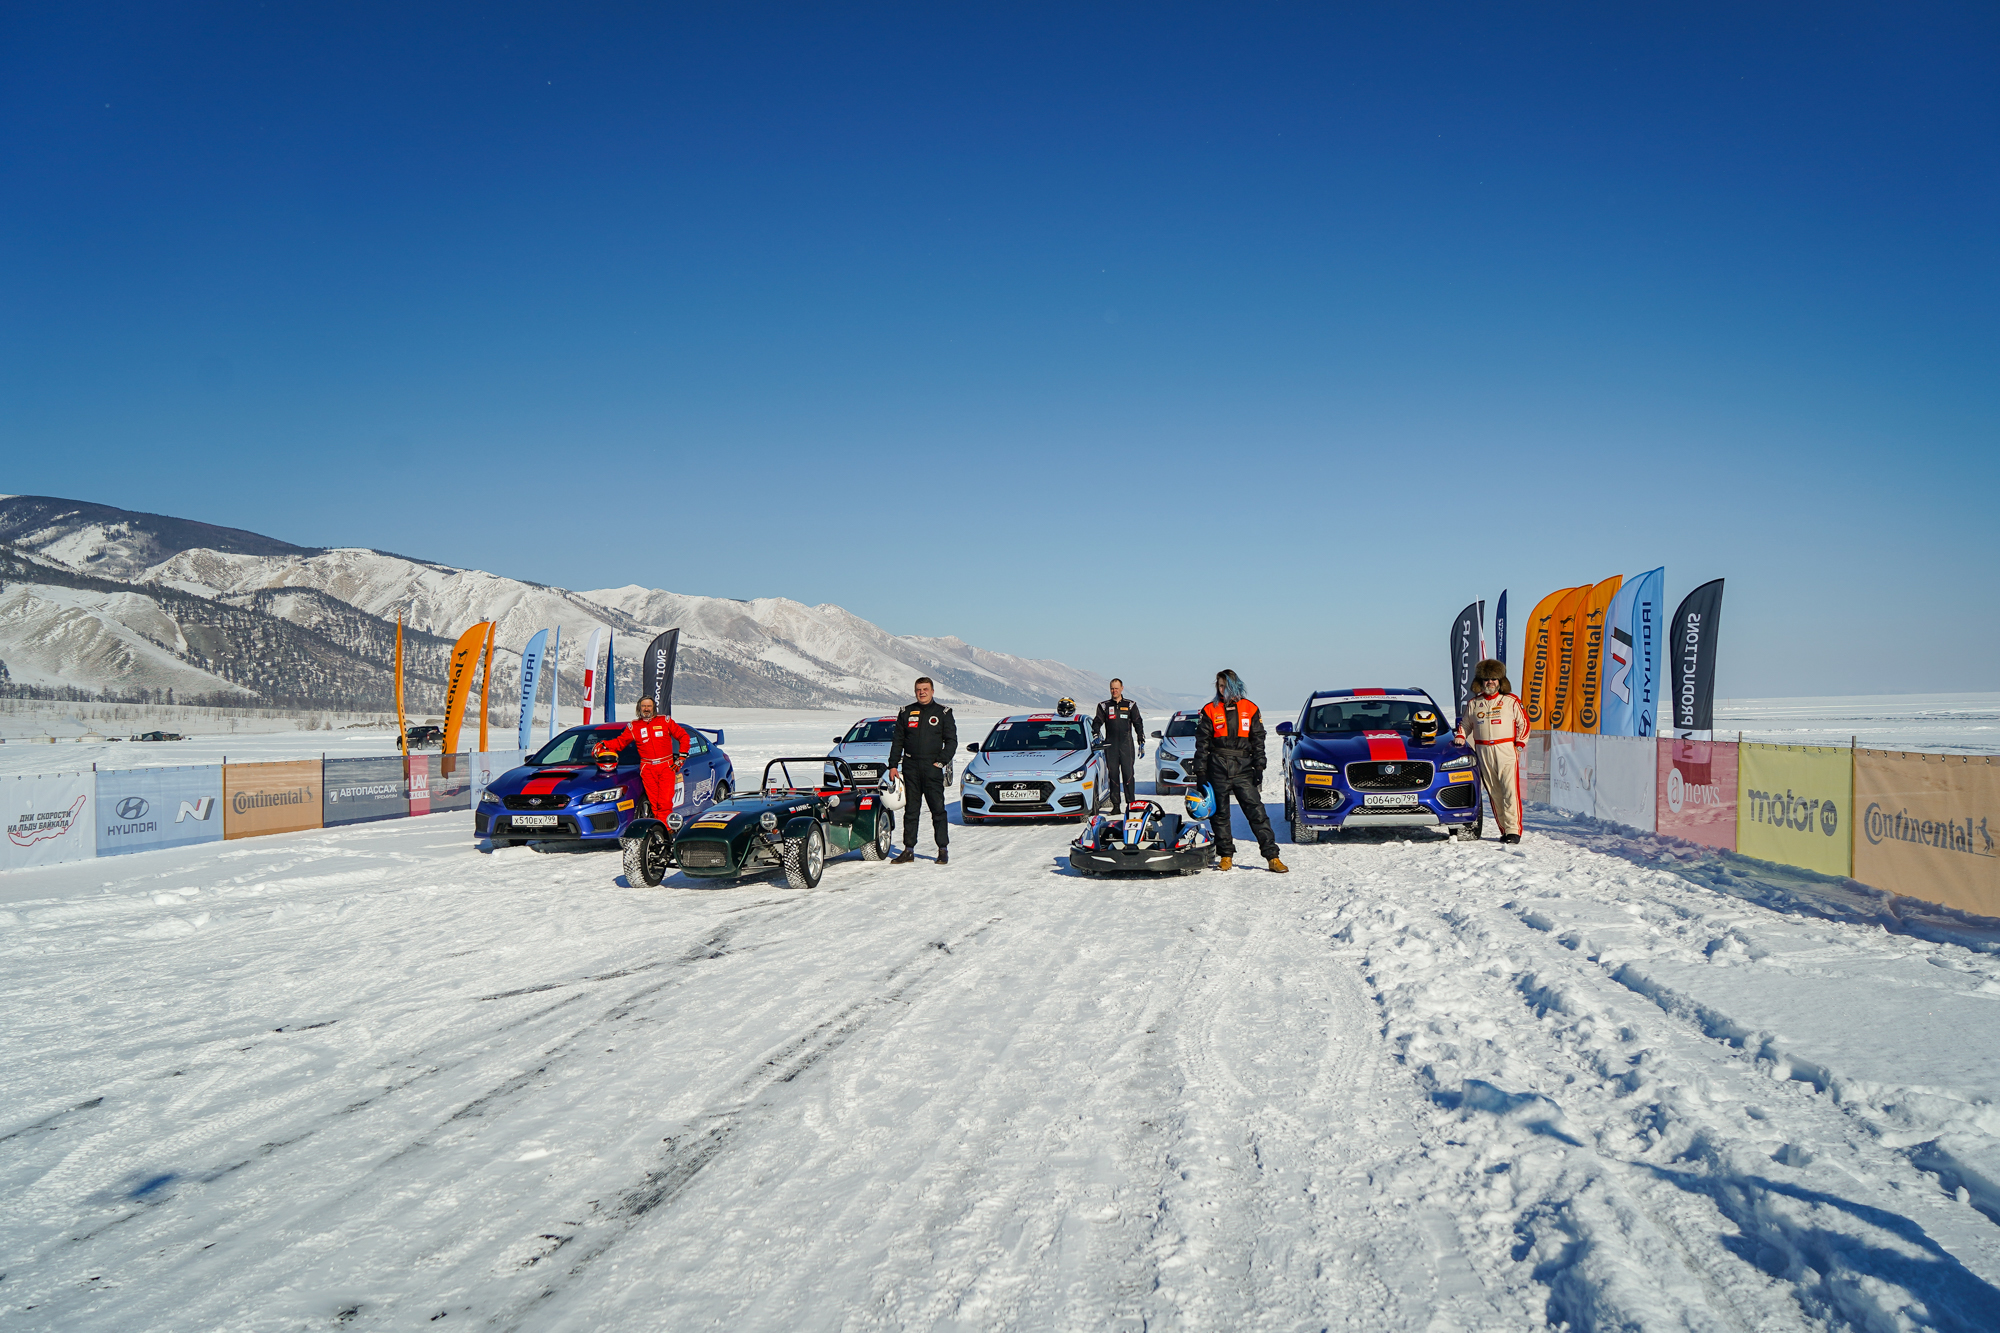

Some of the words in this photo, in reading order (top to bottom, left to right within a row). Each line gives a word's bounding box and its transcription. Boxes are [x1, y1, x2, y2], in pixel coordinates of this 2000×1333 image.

[1642, 601, 1652, 703] HYUNDAI
[1527, 628, 1549, 723] Continental
[1549, 631, 1575, 729] Continental
[1580, 624, 1603, 729] Continental
[339, 783, 399, 798] АВТОПАССАЖ
[411, 774, 428, 790] LAV
[1684, 782, 1720, 807] news
[233, 787, 304, 815] Continental
[1748, 789, 1819, 833] motor
[7, 825, 18, 833] НА
[18, 822, 37, 832] ЛЬДУ
[38, 819, 70, 830] БАЙКАЛА
[19, 813, 35, 823] ДНИ
[37, 810, 72, 821] СКОРОСТИ
[107, 821, 158, 837] HYUNDAI
[1864, 801, 1975, 854] Continental
